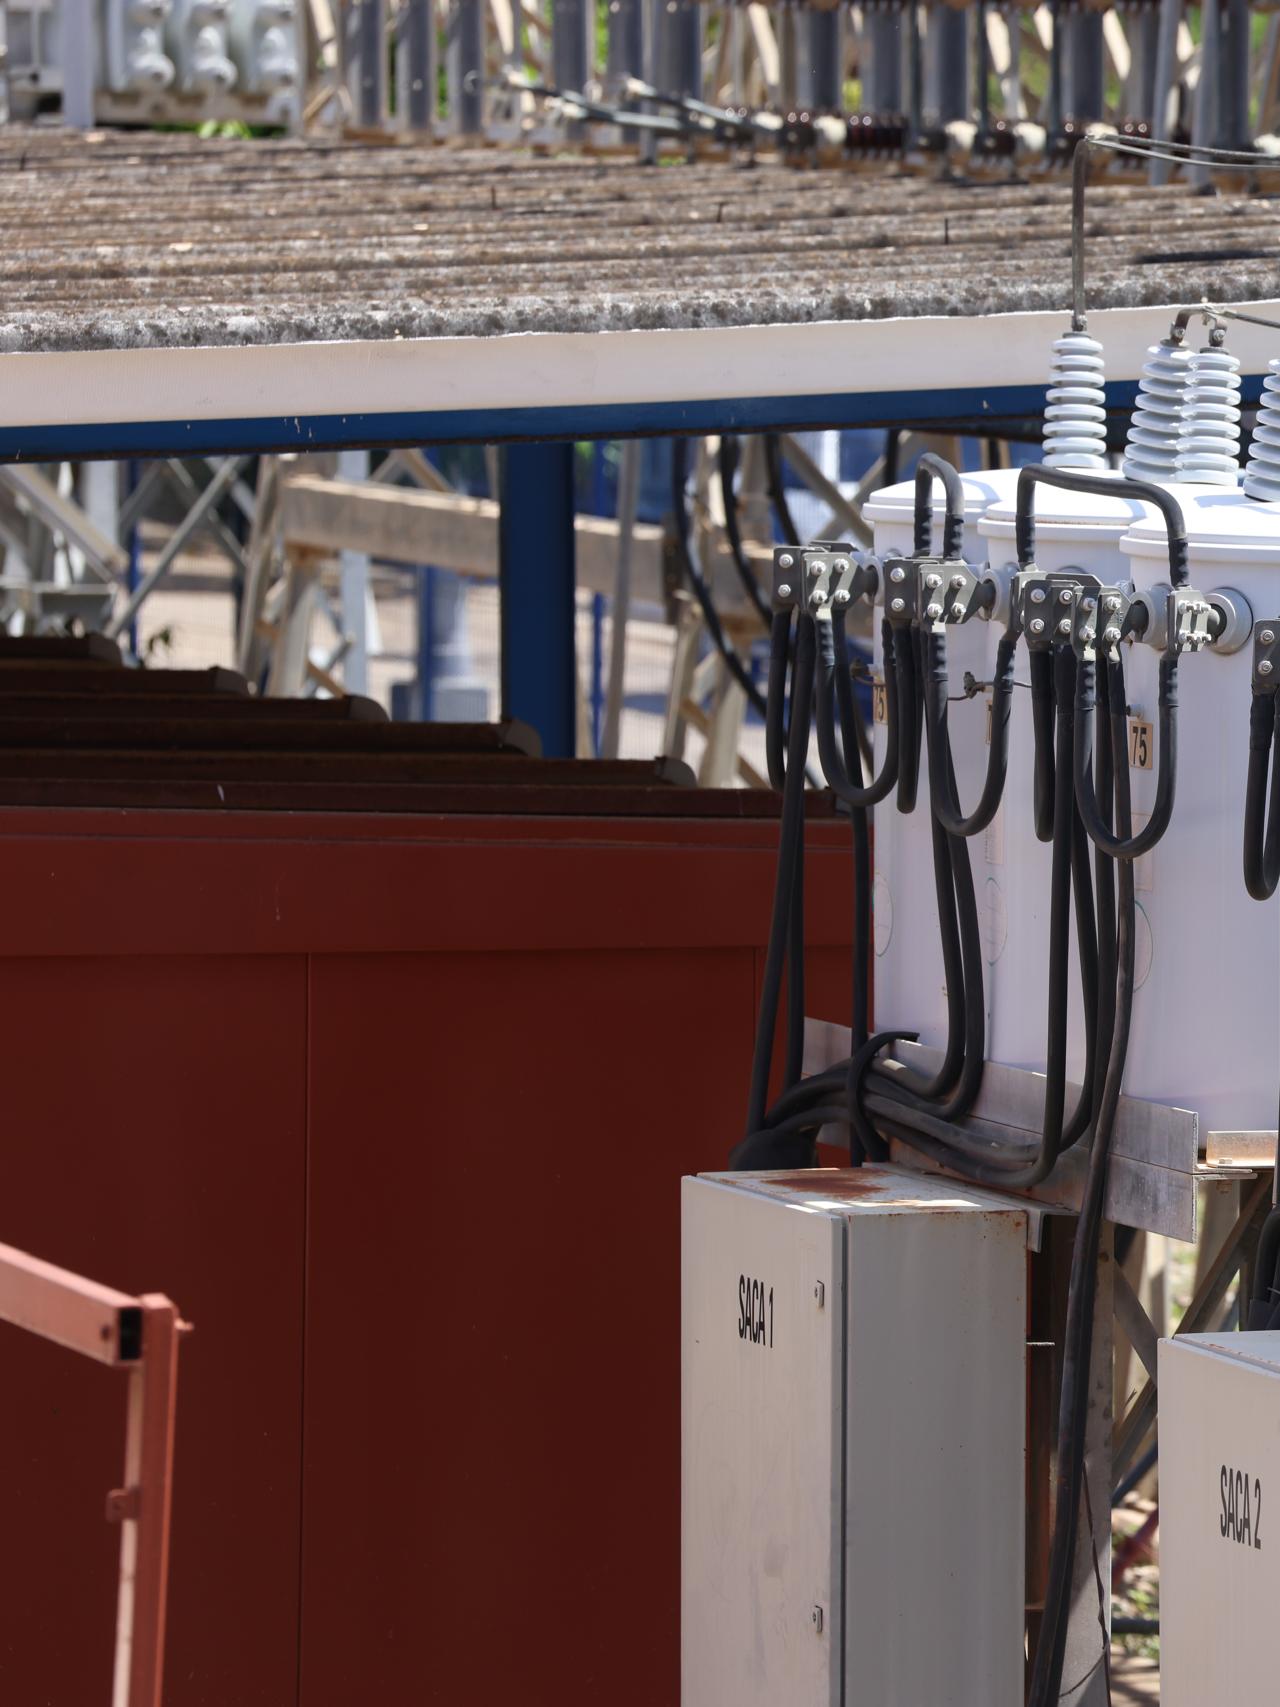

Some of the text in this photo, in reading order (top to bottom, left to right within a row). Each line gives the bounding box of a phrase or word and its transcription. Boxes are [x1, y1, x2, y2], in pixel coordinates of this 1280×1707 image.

[1132, 725, 1148, 767] 75
[738, 1273, 774, 1349] SACA 1
[1219, 1464, 1262, 1550] SACA 2
